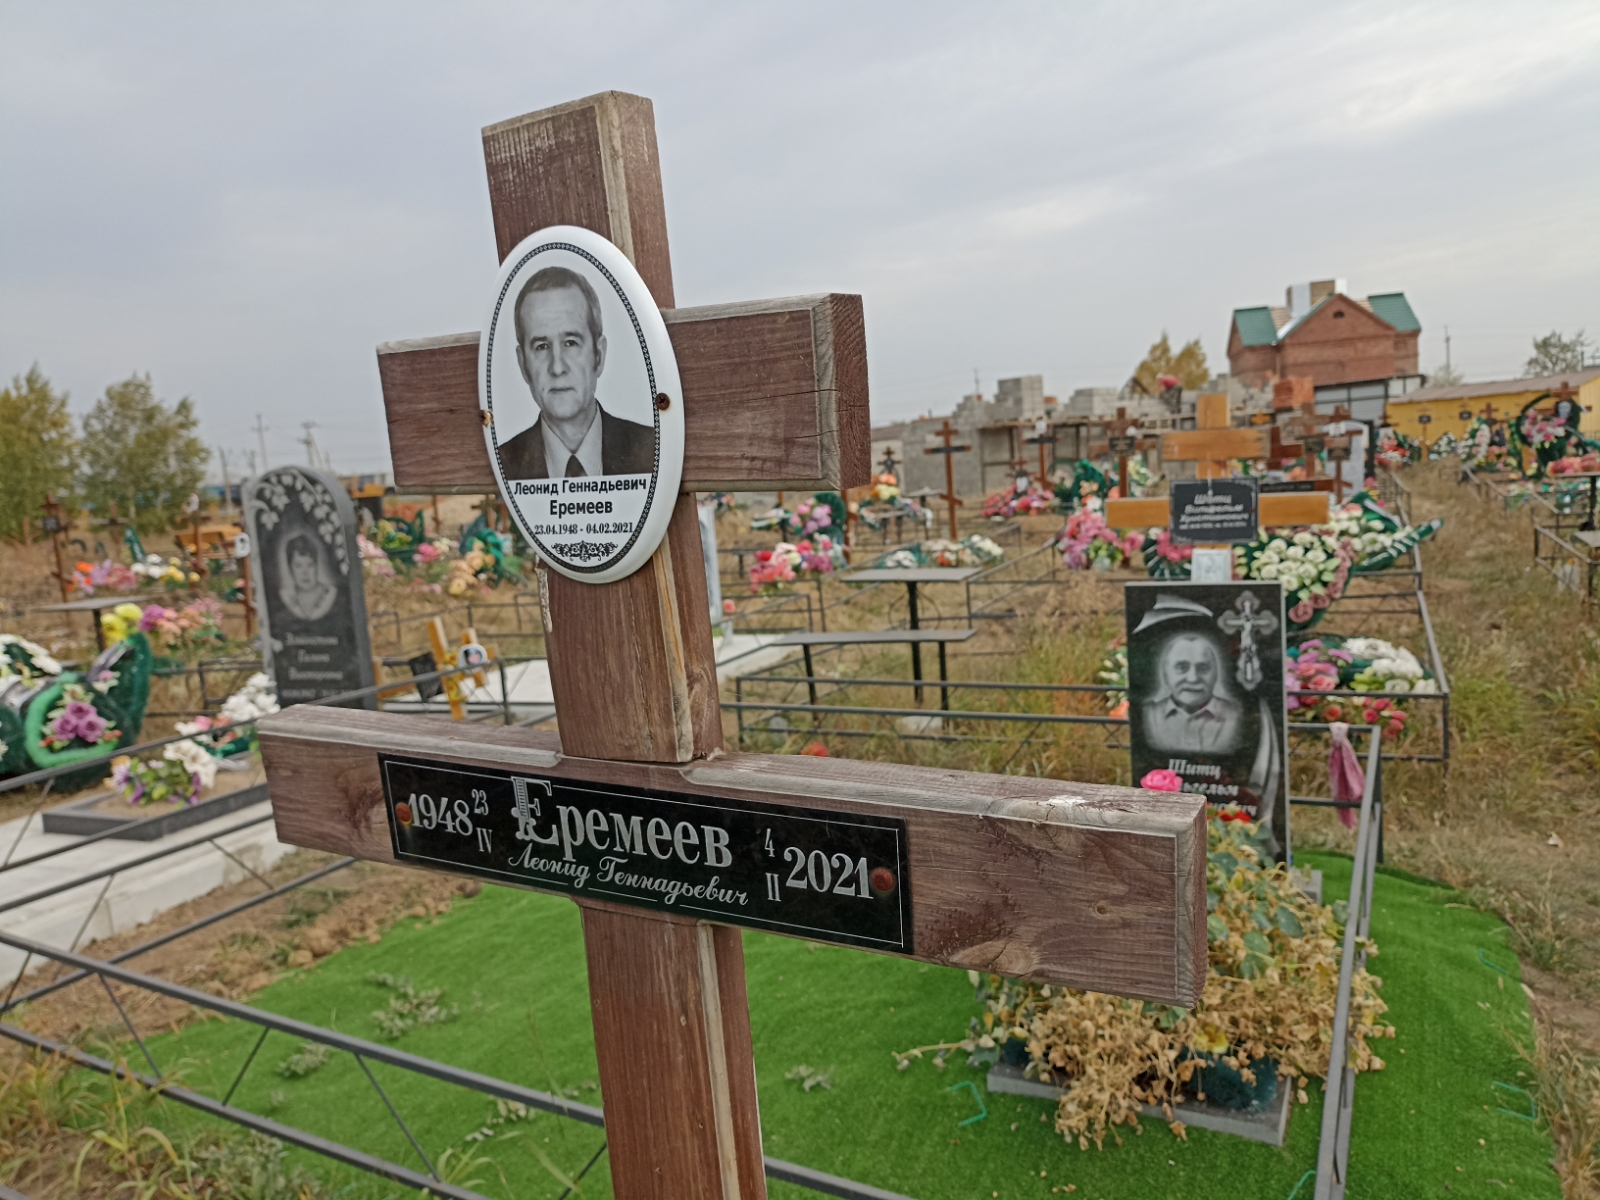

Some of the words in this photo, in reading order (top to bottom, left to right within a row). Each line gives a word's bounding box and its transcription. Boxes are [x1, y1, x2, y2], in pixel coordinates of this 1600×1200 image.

[514, 481, 559, 496] Леонид
[562, 478, 647, 493] Геннадьевич
[549, 500, 613, 519] Еремеев
[534, 523, 578, 535] 23.04.1948
[586, 522, 633, 534] 04.02.2021
[1168, 758, 1222, 781] Шитц
[407, 793, 473, 836] 1948
[471, 787, 489, 817] 23
[510, 776, 733, 868] Еремеев
[476, 827, 493, 854] IV
[764, 827, 776, 858] 4
[508, 842, 591, 888] Леонид
[597, 856, 750, 906] Геннадьевич
[766, 872, 782, 902] II
[783, 845, 874, 900] 2021
